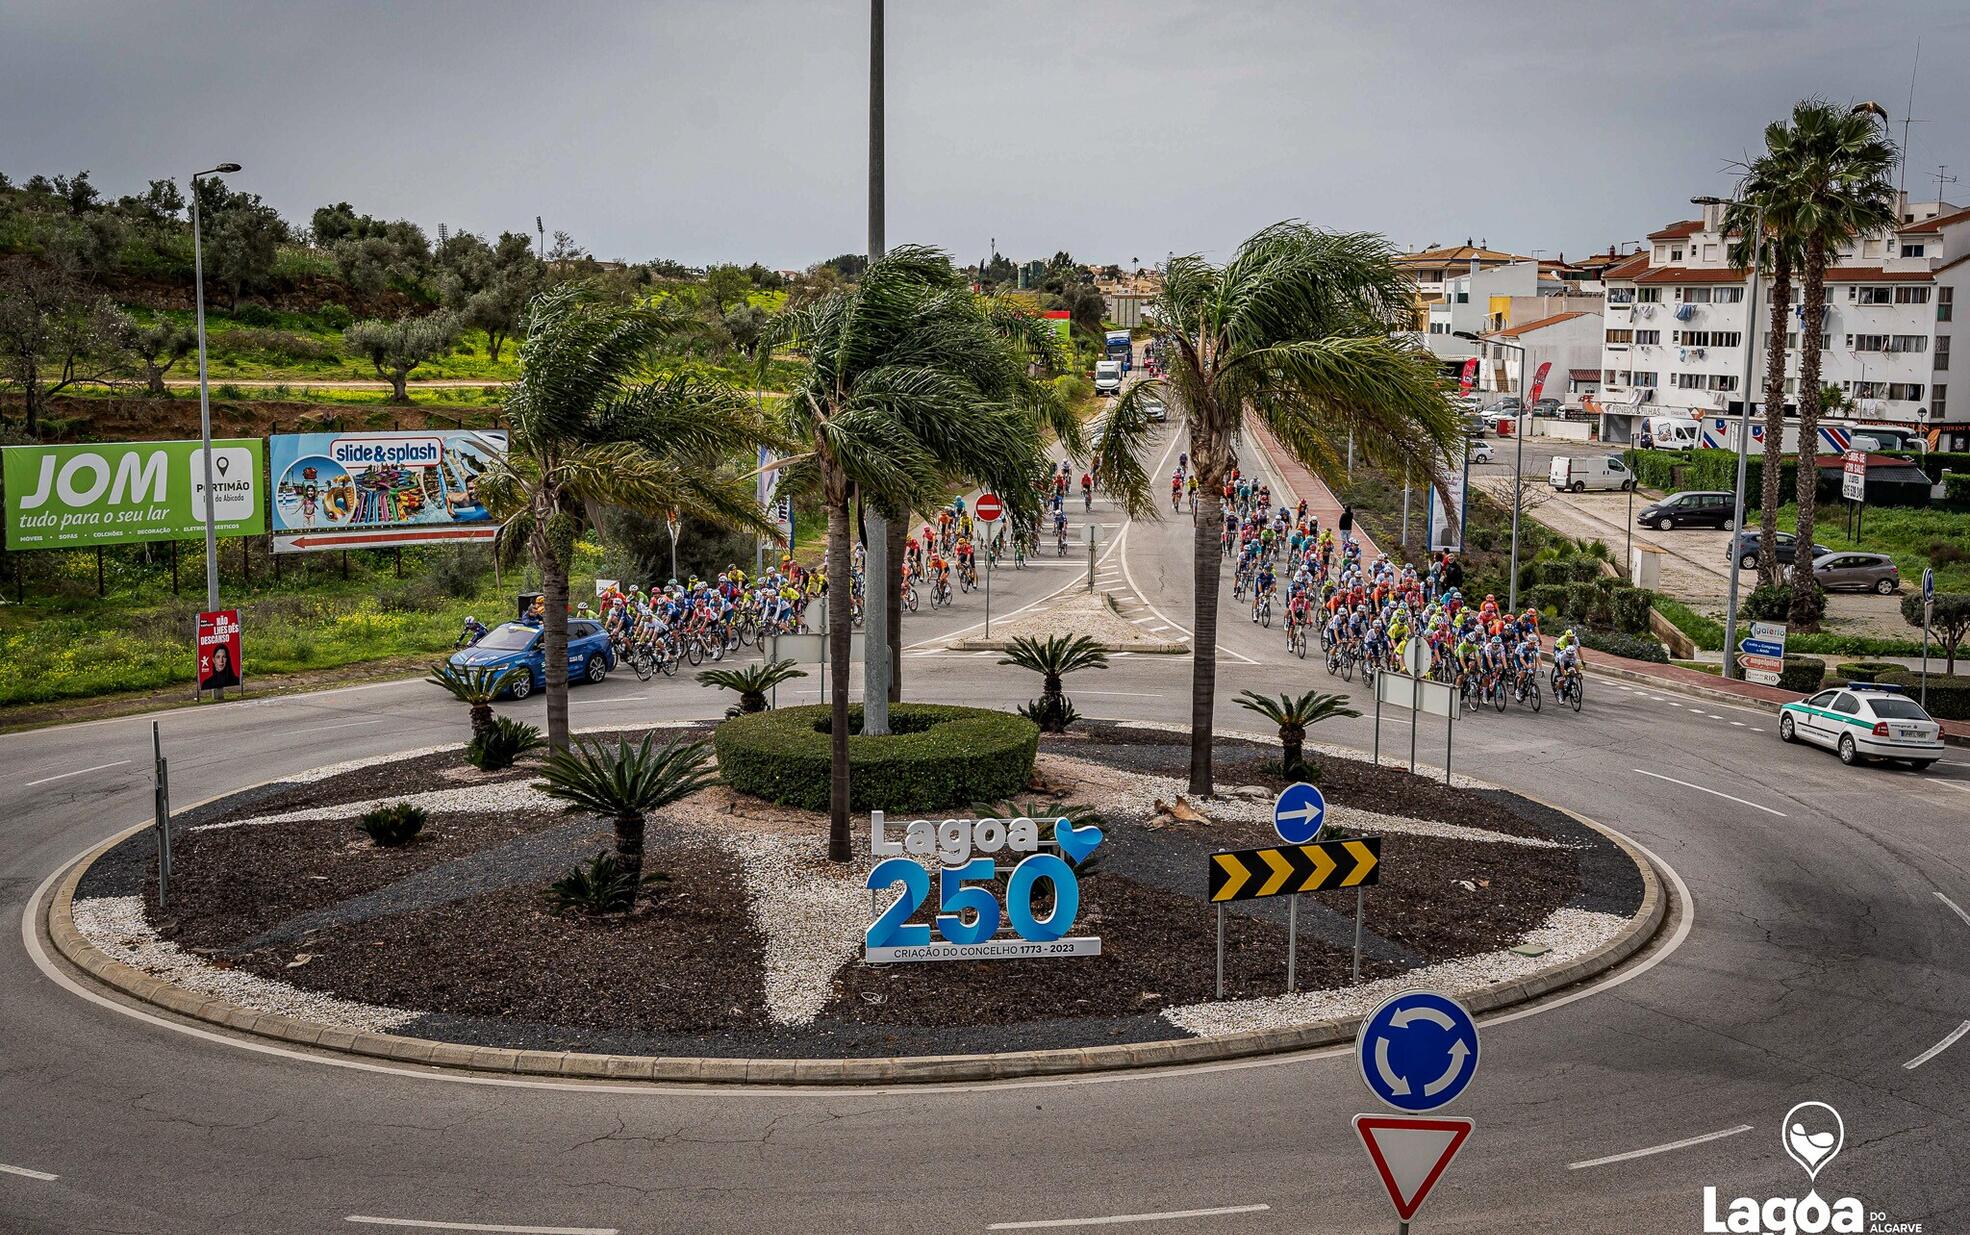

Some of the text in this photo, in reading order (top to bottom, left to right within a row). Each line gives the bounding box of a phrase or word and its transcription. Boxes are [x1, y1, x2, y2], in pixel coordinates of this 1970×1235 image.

[1845, 462, 1864, 474] FOR SALE
[19, 450, 168, 509] JOM
[196, 480, 250, 492] PRTIMÃO
[20, 505, 170, 530] tudo para o seu lar
[216, 615, 228, 626] NÃO
[214, 623, 239, 635] LHES DÊS
[201, 635, 229, 645] DESCANSO
[871, 810, 1038, 864] Lagoa
[866, 853, 1079, 947] 250
[894, 947, 940, 959] CRIAÇÃO
[943, 949, 958, 957] DO
[961, 946, 1018, 956] CONCELHO
[1020, 945, 1042, 953] 1773
[1050, 944, 1075, 953] 2023
